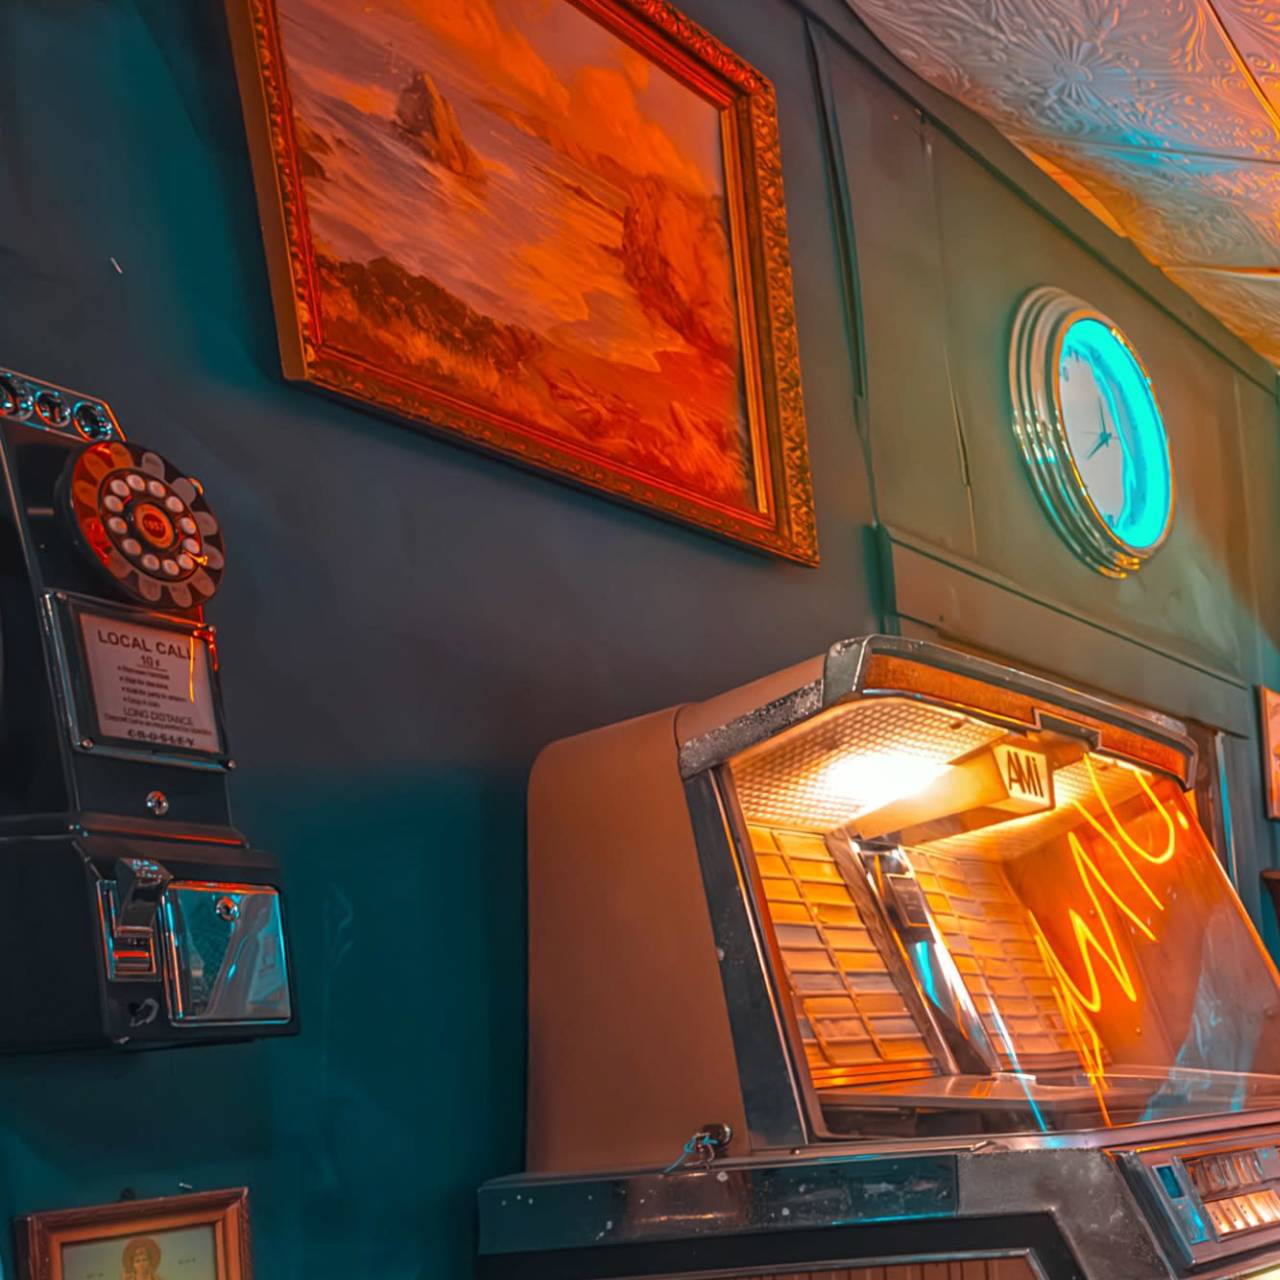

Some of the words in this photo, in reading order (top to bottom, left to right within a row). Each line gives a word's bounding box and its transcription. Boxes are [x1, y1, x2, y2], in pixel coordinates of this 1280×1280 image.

[97, 628, 153, 653] LOCAL
[155, 641, 196, 661] CALL
[123, 706, 150, 721] LONG
[150, 709, 194, 727] DISTANCE
[127, 727, 196, 747] CROSLEY
